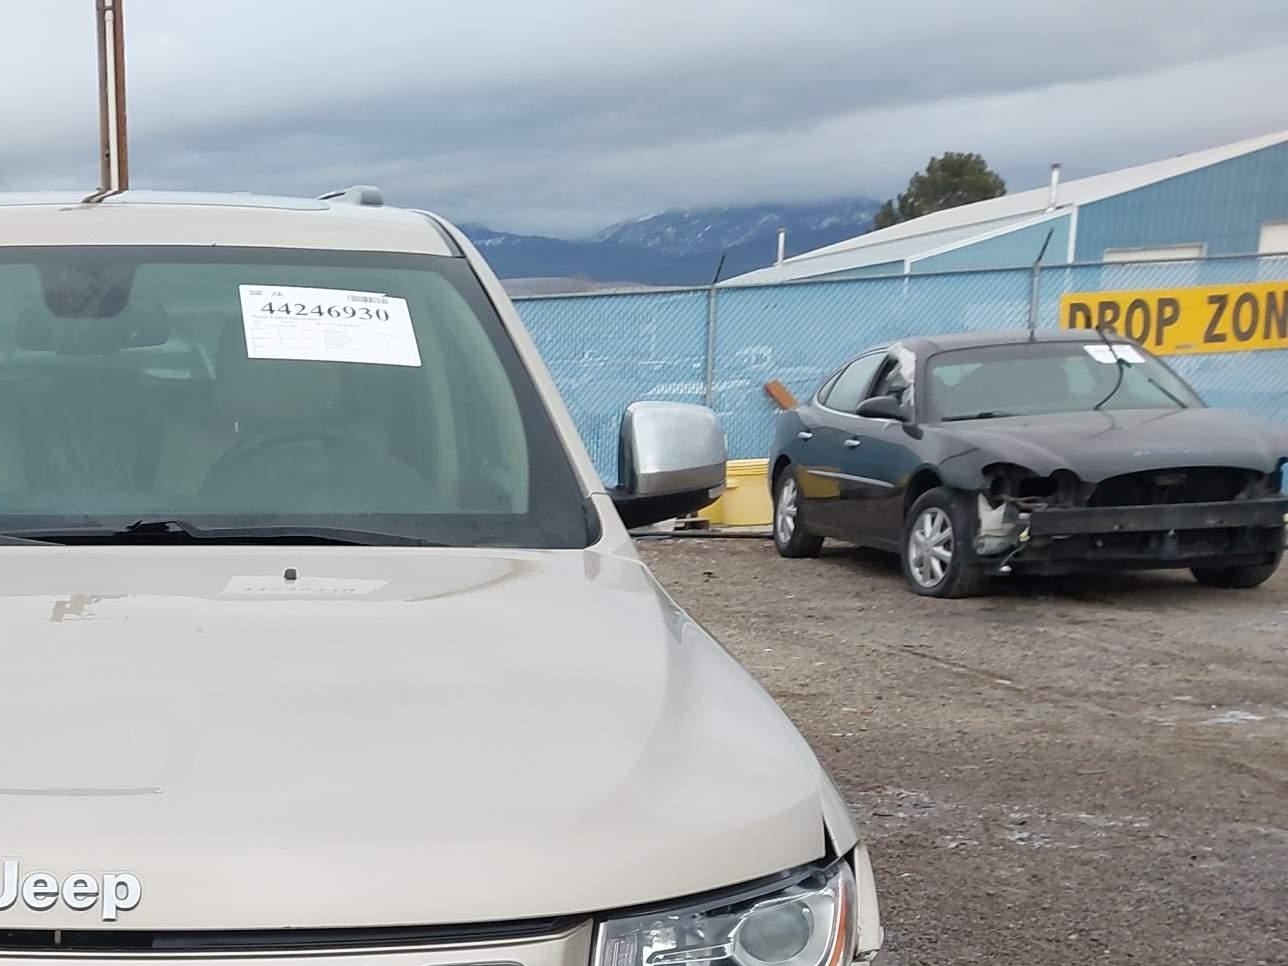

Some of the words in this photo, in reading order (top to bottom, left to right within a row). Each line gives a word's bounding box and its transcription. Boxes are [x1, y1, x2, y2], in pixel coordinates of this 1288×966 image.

[260, 301, 390, 322] 44246930
[1068, 297, 1181, 346] DROP
[1204, 290, 1288, 343] ZON
